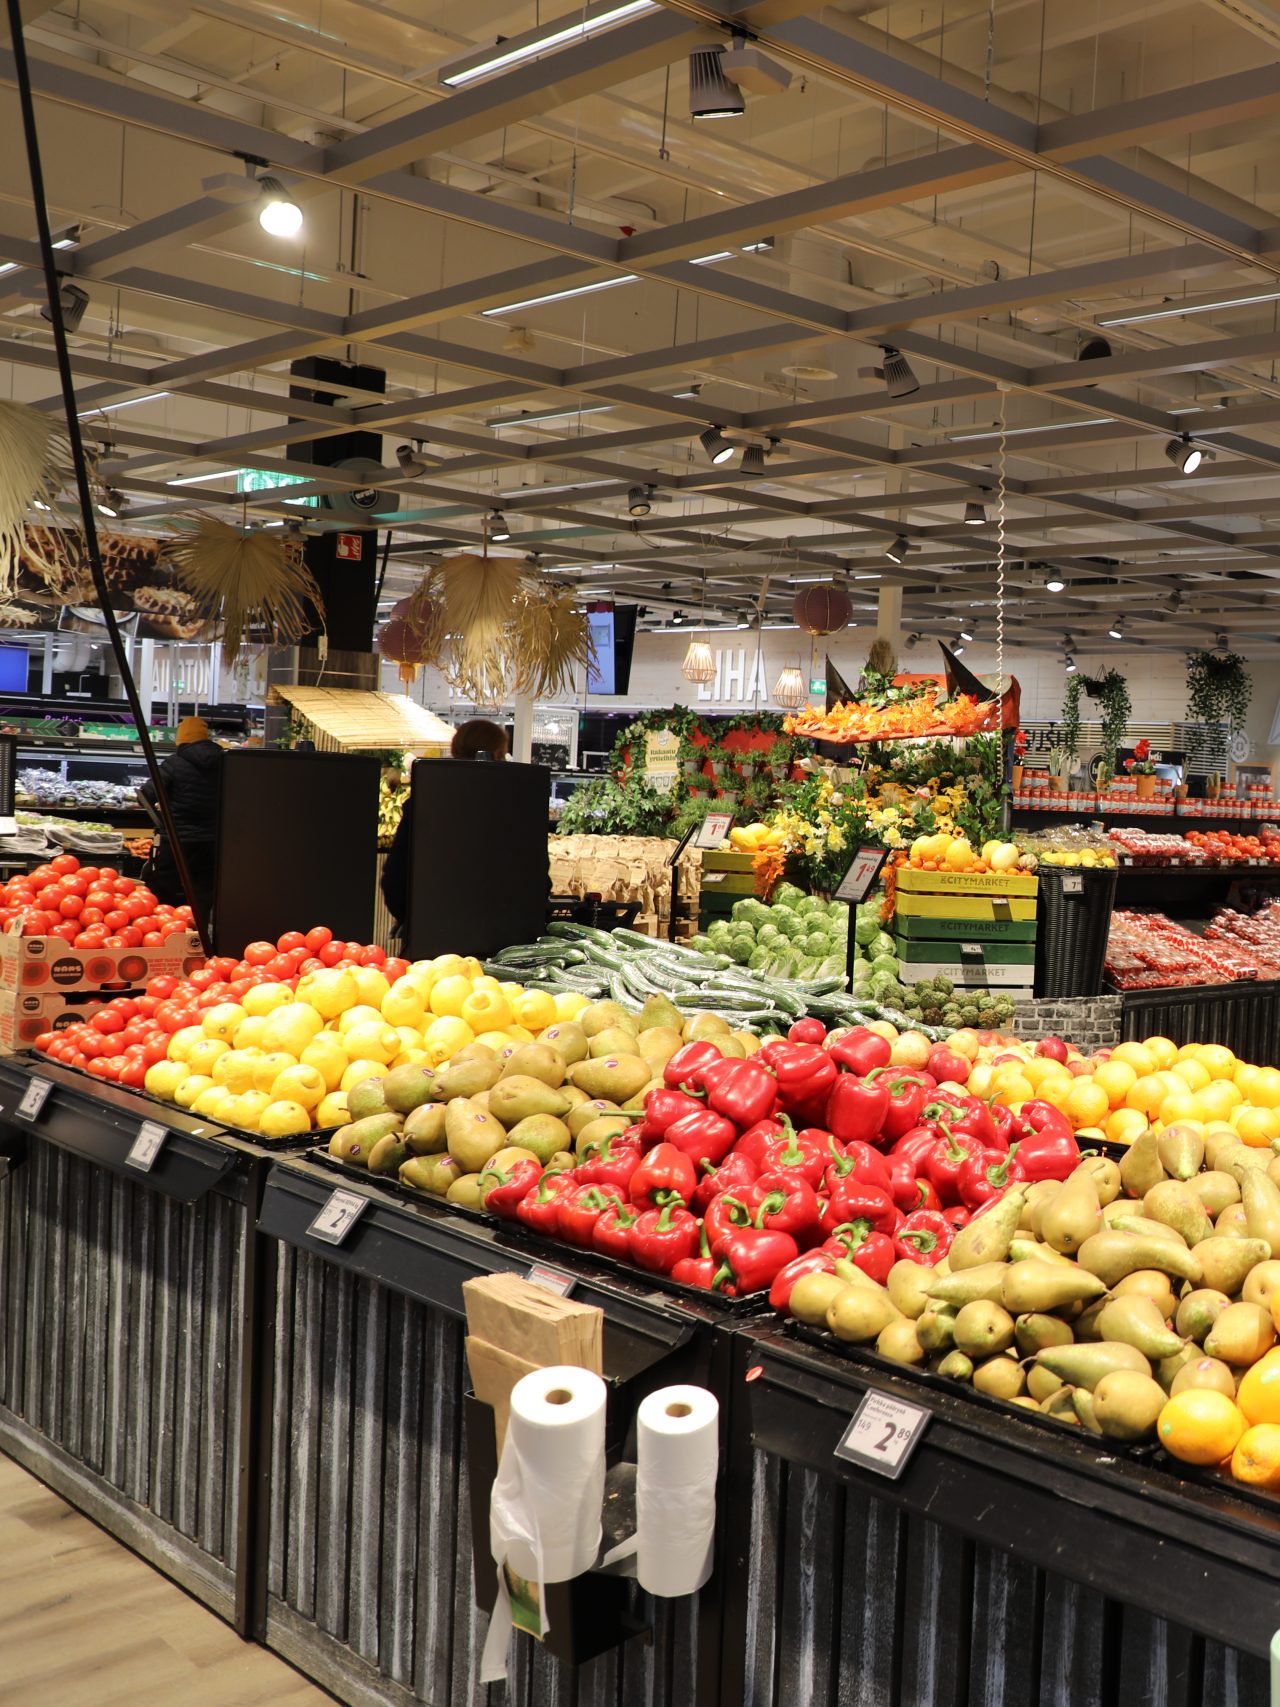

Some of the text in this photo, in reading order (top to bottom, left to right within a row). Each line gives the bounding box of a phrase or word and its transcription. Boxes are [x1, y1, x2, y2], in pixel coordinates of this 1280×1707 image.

[329, 1208, 347, 1228] 2
[873, 1421, 911, 1452] 2 89
